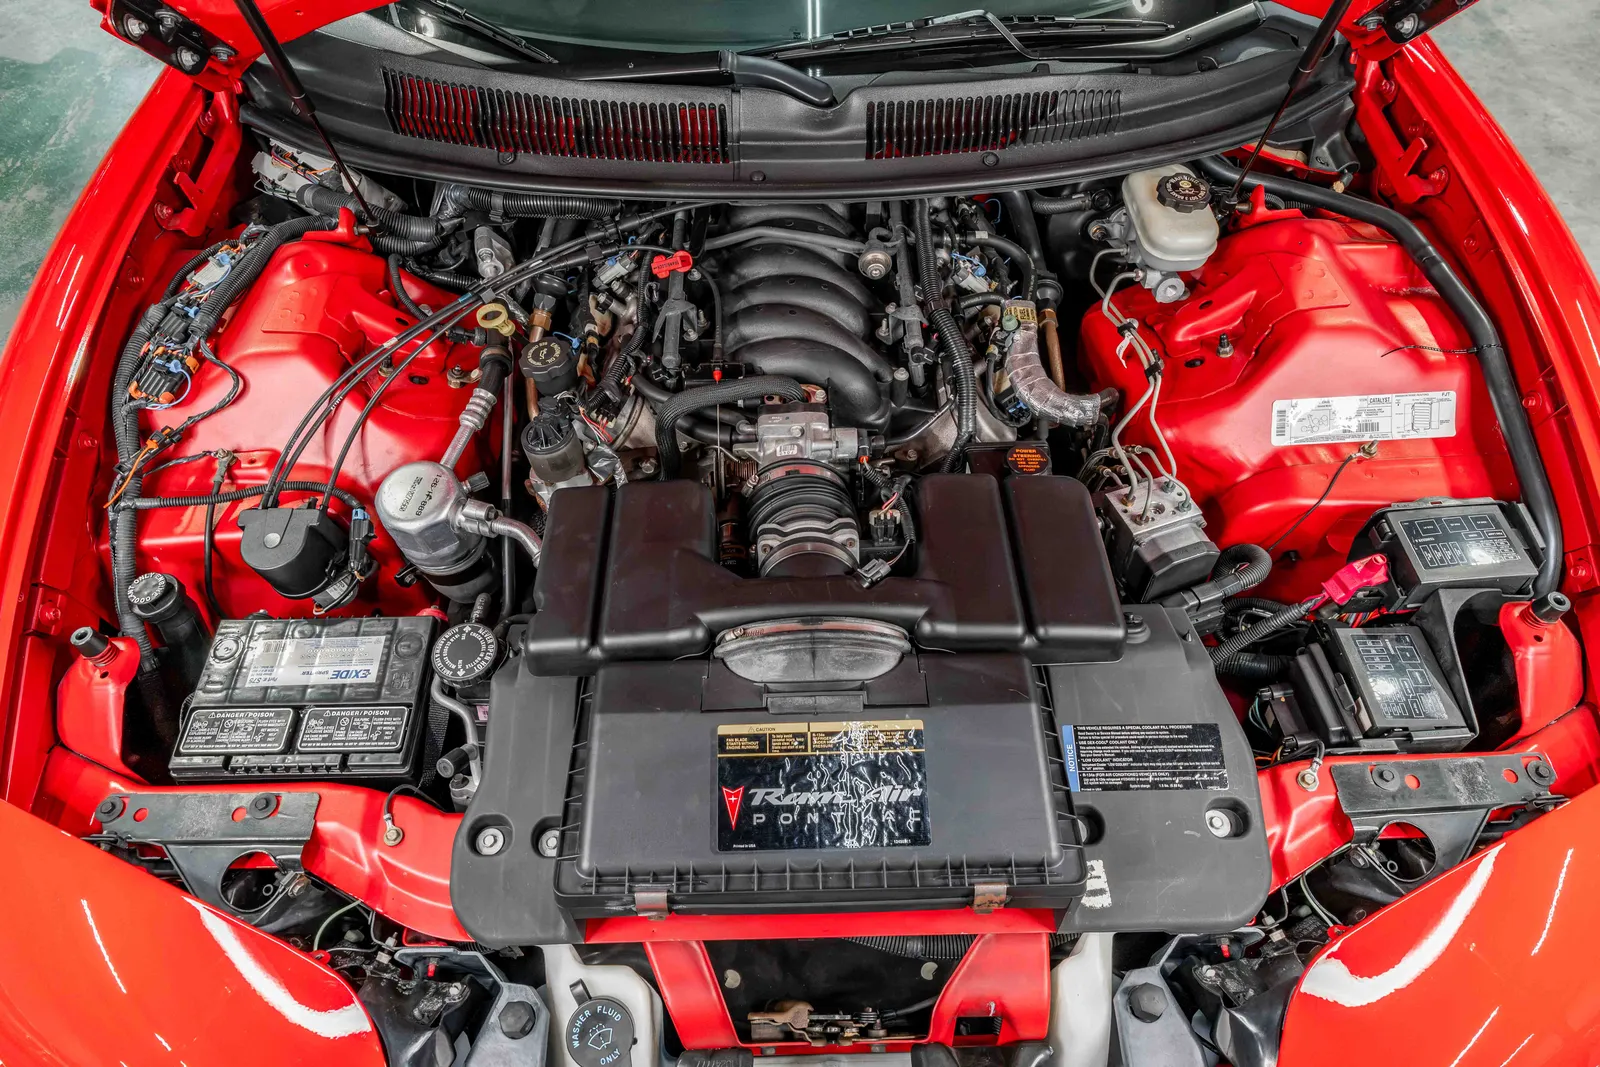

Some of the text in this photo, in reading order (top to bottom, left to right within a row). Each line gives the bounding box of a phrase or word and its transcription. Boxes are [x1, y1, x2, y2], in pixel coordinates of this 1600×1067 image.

[134, 572, 156, 584] ONLY
[474, 627, 495, 673] NEVER OPEN HOT
[330, 669, 371, 680] EXIDE
[1067, 744, 1075, 772] NOTICE
[749, 784, 922, 805] Ram Air
[572, 1006, 621, 1048] WASHER FLUID
[600, 1048, 620, 1065] ONLY
